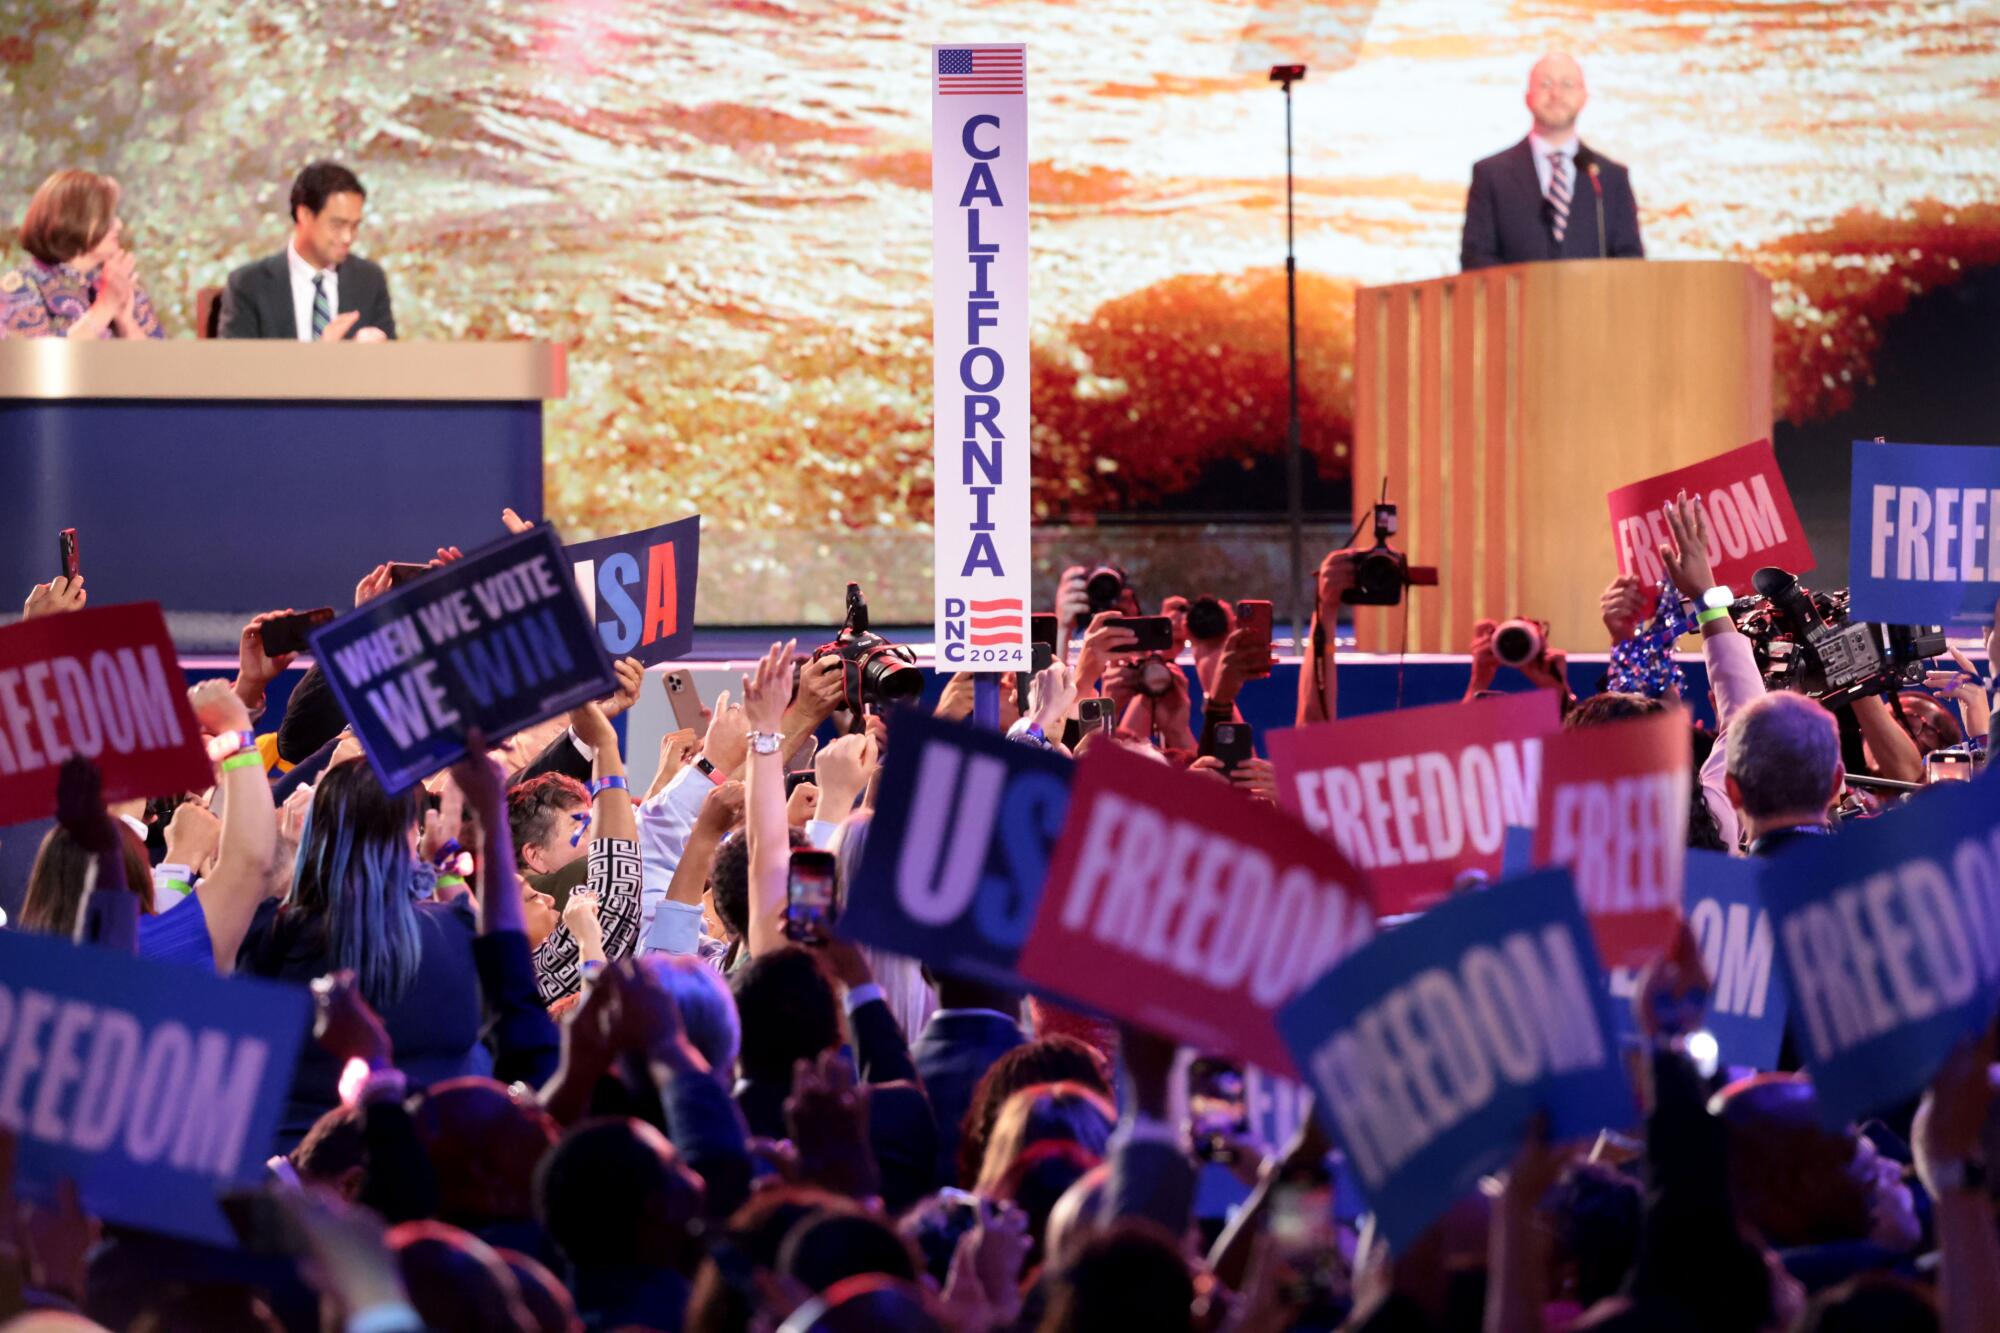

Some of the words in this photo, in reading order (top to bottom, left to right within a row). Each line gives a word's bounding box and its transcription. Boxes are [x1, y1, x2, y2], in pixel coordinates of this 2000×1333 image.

[959, 114, 1005, 577] CALIFORNIA
[1618, 473, 1788, 588] FREDOM
[333, 613, 424, 689] WHEN
[417, 588, 482, 646] WE
[472, 554, 561, 621] VOTE
[365, 659, 461, 750] WE
[451, 609, 575, 708] WIN
[944, 598, 966, 662] DNC
[970, 649, 1023, 662] 2024
[0, 983, 268, 1180] EEDOM
